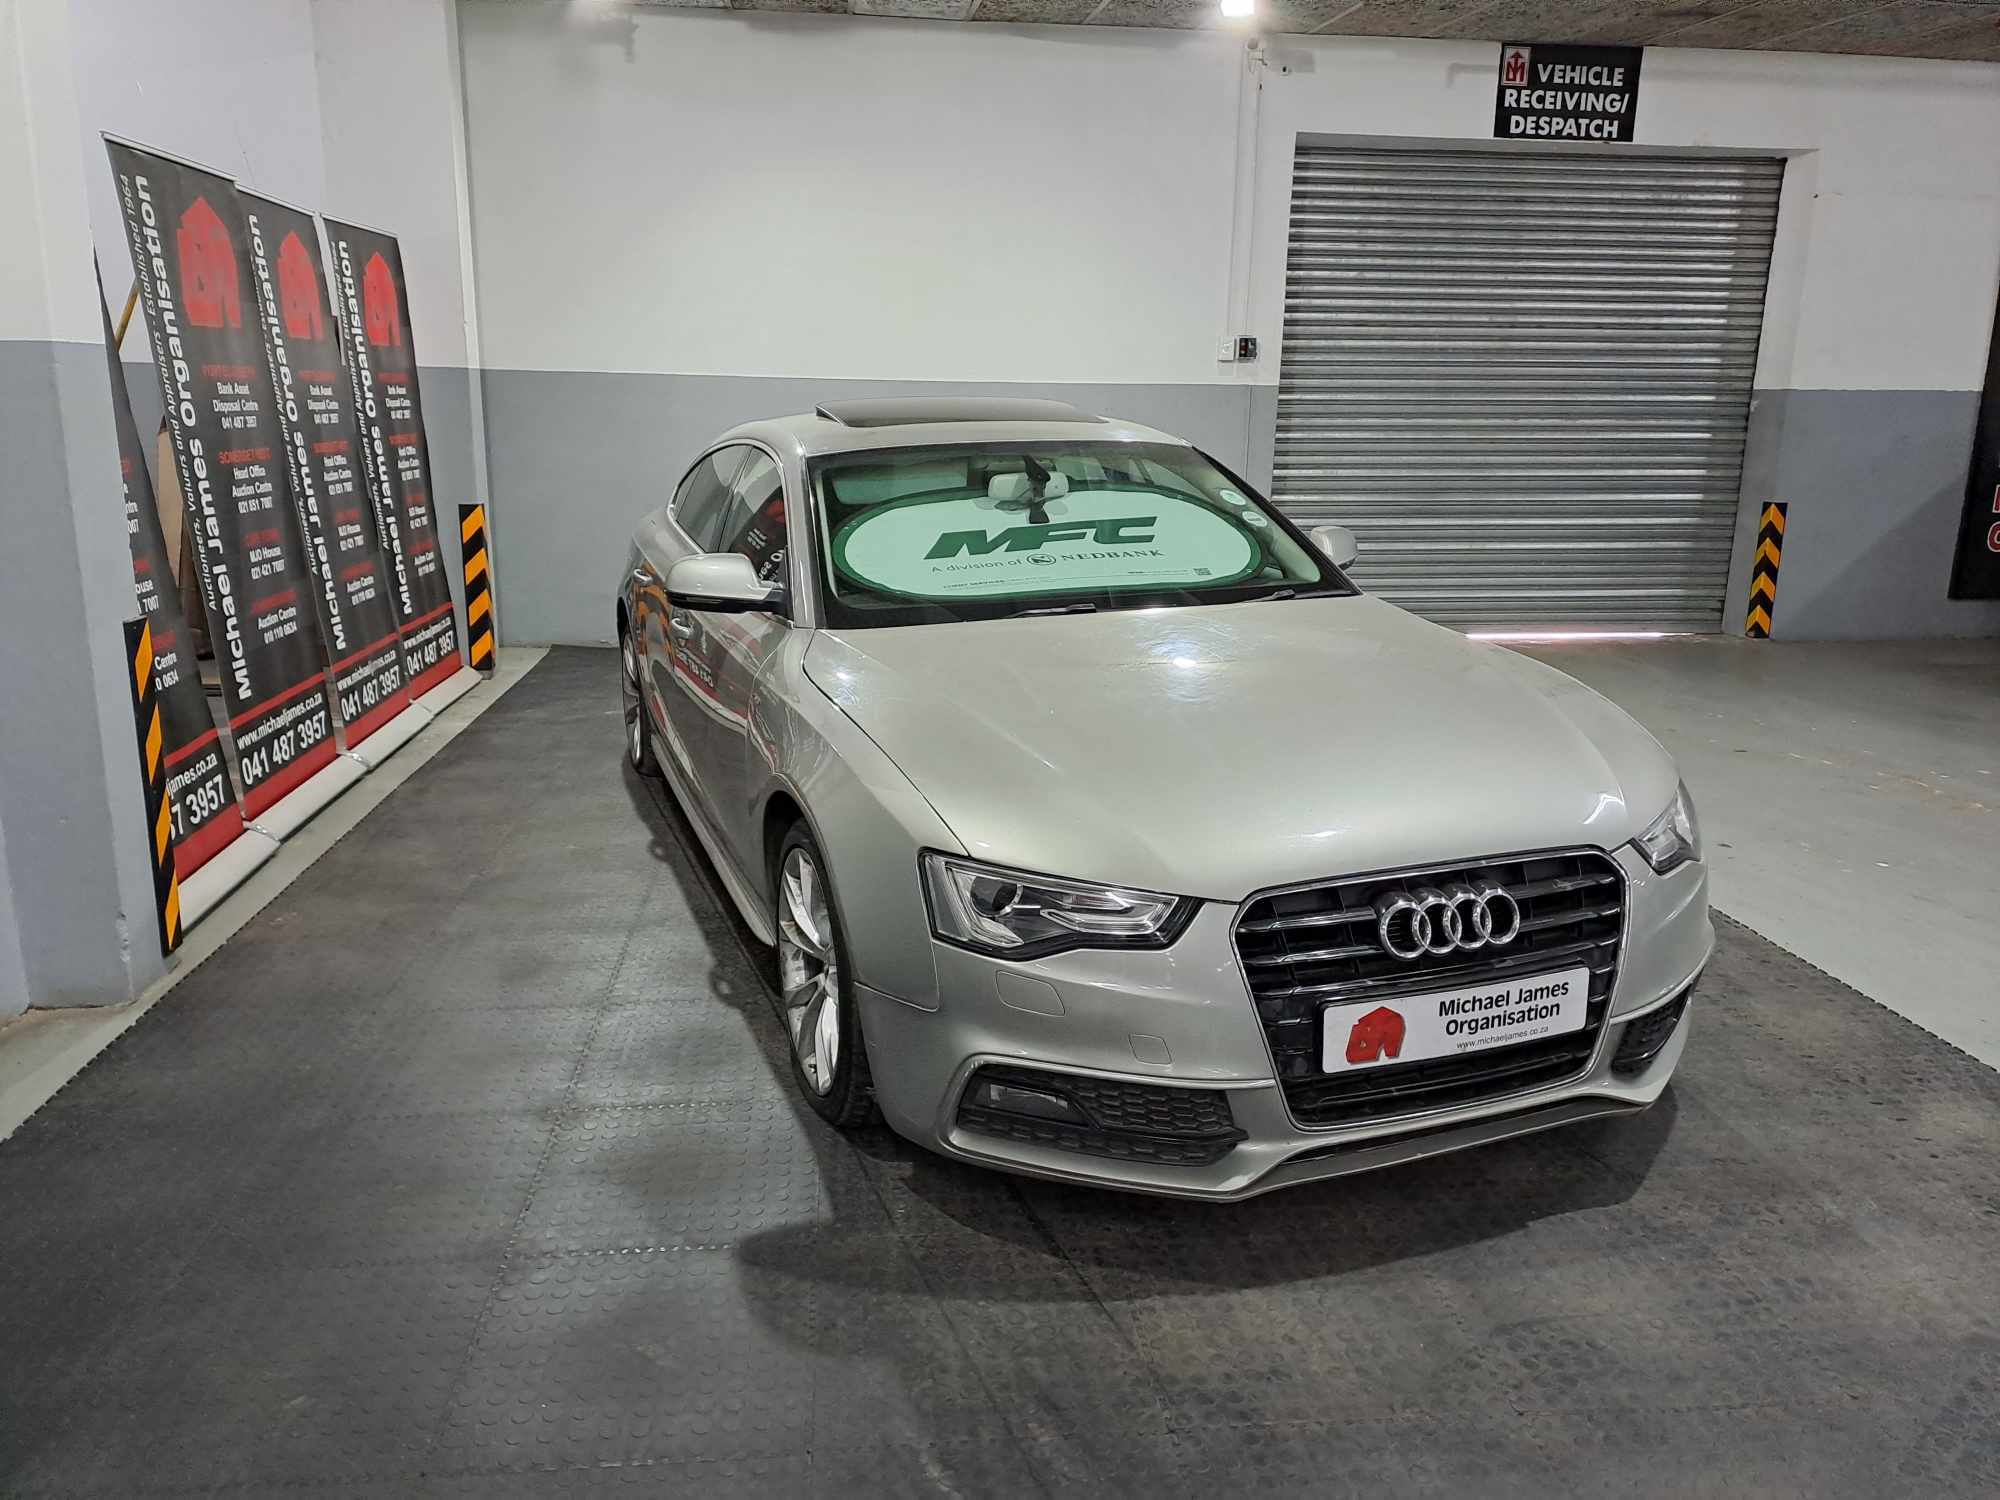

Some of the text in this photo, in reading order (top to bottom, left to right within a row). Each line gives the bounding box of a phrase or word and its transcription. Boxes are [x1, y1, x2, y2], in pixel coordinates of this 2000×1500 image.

[1537, 63, 1625, 87] VEHICLE
[1504, 88, 1630, 114] RECEIVING/
[1509, 115, 1619, 138] DESPATCH
[120, 174, 136, 216] 1964
[129, 220, 156, 316] Established
[248, 214, 298, 422] Organisation
[153, 331, 177, 415] Appraisers
[212, 400, 240, 414] Disposal
[279, 415, 290, 440] and
[338, 240, 412, 615] Michael James Organisation
[356, 411, 367, 435] and
[135, 175, 252, 700] Michael James Organisation
[170, 418, 184, 450] and
[179, 454, 196, 512] Valuers
[293, 431, 321, 528] James
[923, 516, 1158, 560] MFC
[946, 560, 1004, 571] division
[1007, 558, 1023, 566] of
[1061, 549, 1166, 561] NEDBANK
[193, 518, 217, 610] Auctioneers,
[313, 536, 346, 650] Michael
[154, 652, 177, 670] Centre
[406, 630, 454, 675] 041 487 3957
[341, 665, 400, 721] 041 487 3957
[237, 693, 323, 750] www.michaeljames.co.za
[241, 710, 326, 785] 041 487 3957
[185, 774, 225, 824] 3957
[1439, 981, 1569, 1017] Michael James
[1445, 1002, 1560, 1035] Organisation
[1456, 1025, 1549, 1050] www.michaeljames.co.za
